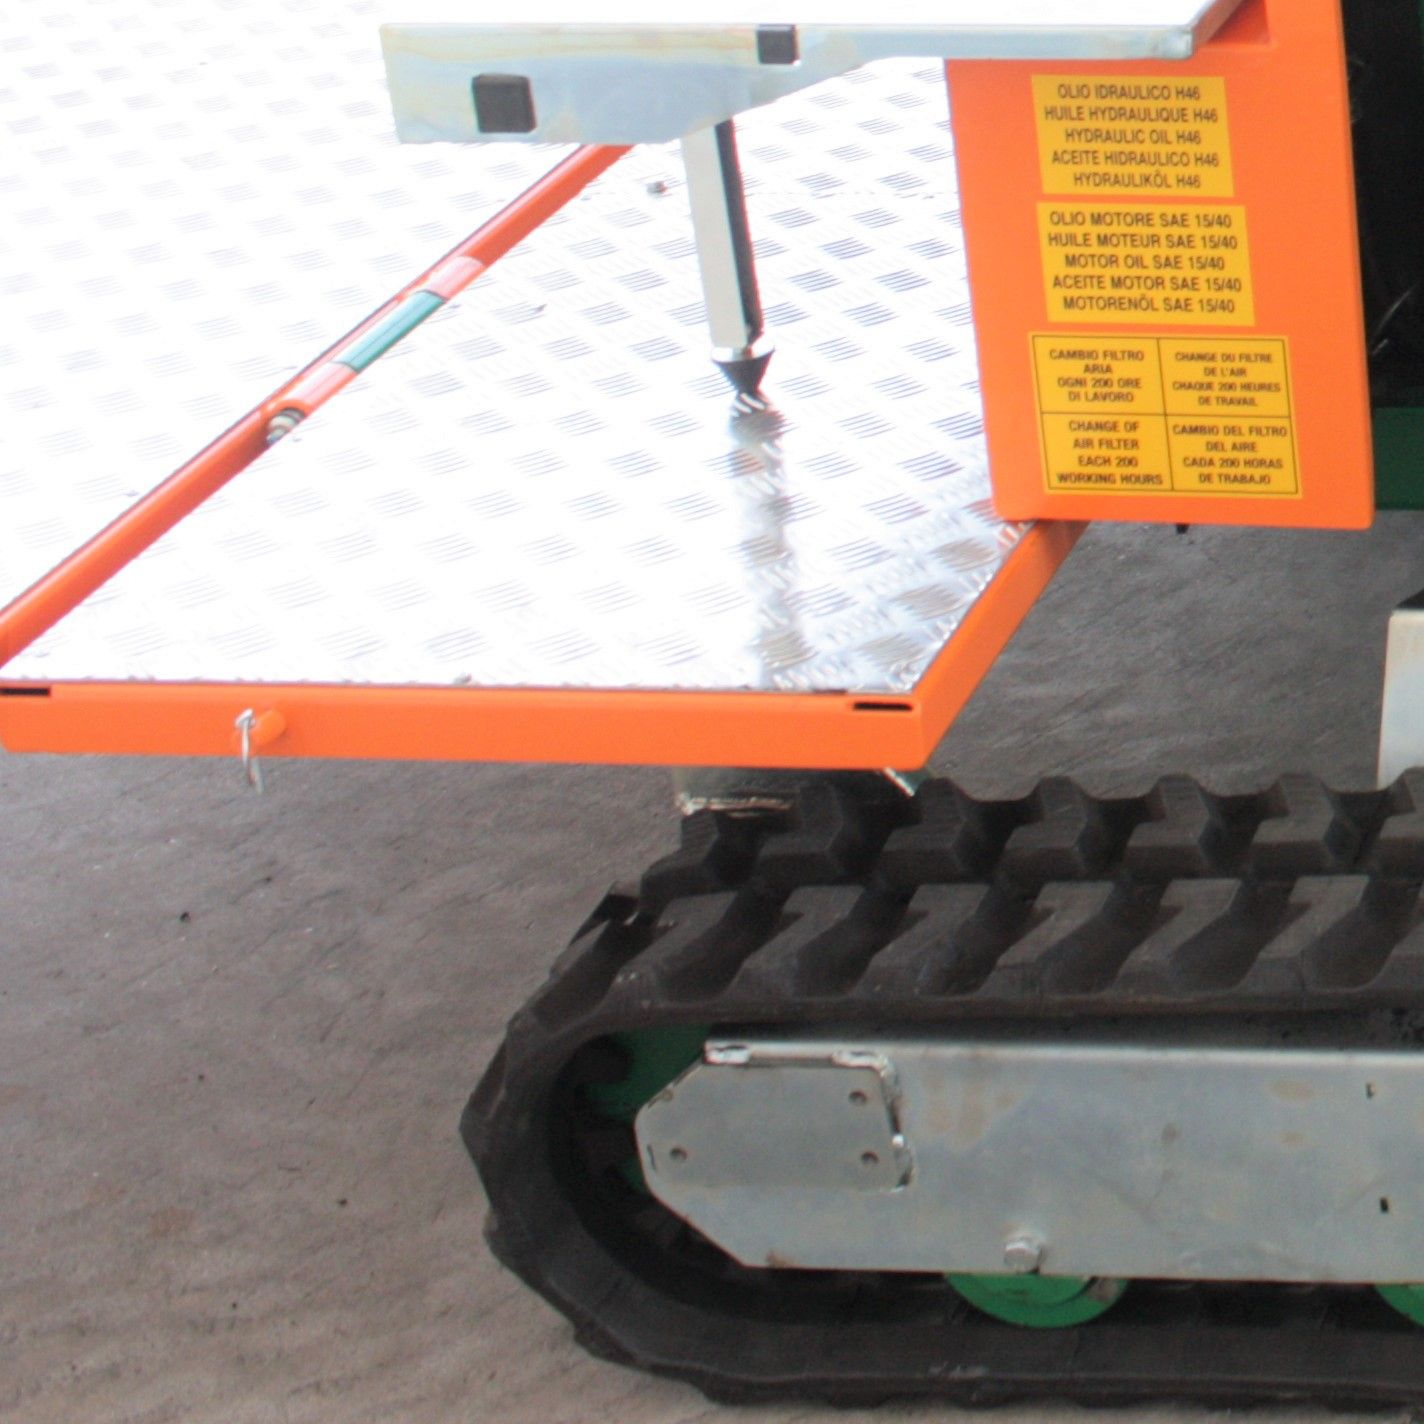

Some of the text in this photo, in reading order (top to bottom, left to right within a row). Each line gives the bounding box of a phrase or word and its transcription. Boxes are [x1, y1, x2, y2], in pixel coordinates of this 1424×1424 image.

[1057, 84, 1200, 101] OLIO IDRAULICO H46
[1044, 106, 1218, 123] HUILE HYDRAULIQUE H46
[1065, 128, 1201, 145] HYDRAULIC OIL H46
[1052, 150, 1219, 167] ACEITE HIDRAULICO H46
[1074, 170, 1201, 188] HYDRAULIKÖL H46
[1050, 211, 1232, 229] OLIO MOTORE SAE 15/40
[1048, 233, 1238, 250] HUILE MOTEUR SAE 15/40
[1065, 254, 1225, 271] MOTOR OIL SAE 15/40
[1053, 275, 1241, 292] ACEITE MOTOR SAE 15/40
[1063, 294, 1235, 313] MOTORENÖL SAE 15/40
[1050, 350, 1144, 361] CAMBIO FILTRO
[1175, 353, 1272, 363] CHANGE DU FILTRE
[1084, 364, 1113, 374] ARIA
[1204, 367, 1247, 376] DE L'AIR
[1057, 377, 1142, 388] OGNI 200 ORE
[1172, 381, 1281, 392] CHAQUE 200 HEURES
[1068, 392, 1134, 402] DI LAVORO
[1198, 396, 1257, 406] DE TRAVAIL
[1069, 421, 1139, 432] CHANGE OF
[1172, 425, 1287, 437] CAMBIO DEL FILTRO
[1074, 438, 1140, 450] AIR FILTER
[1206, 442, 1257, 452] DEL AIRE
[1078, 456, 1138, 467] EACH 200
[1183, 457, 1283, 469] CADA 200 HORAS
[1057, 473, 1163, 485] WORKING HOURS
[1199, 473, 1271, 484] DE TRABAJO
